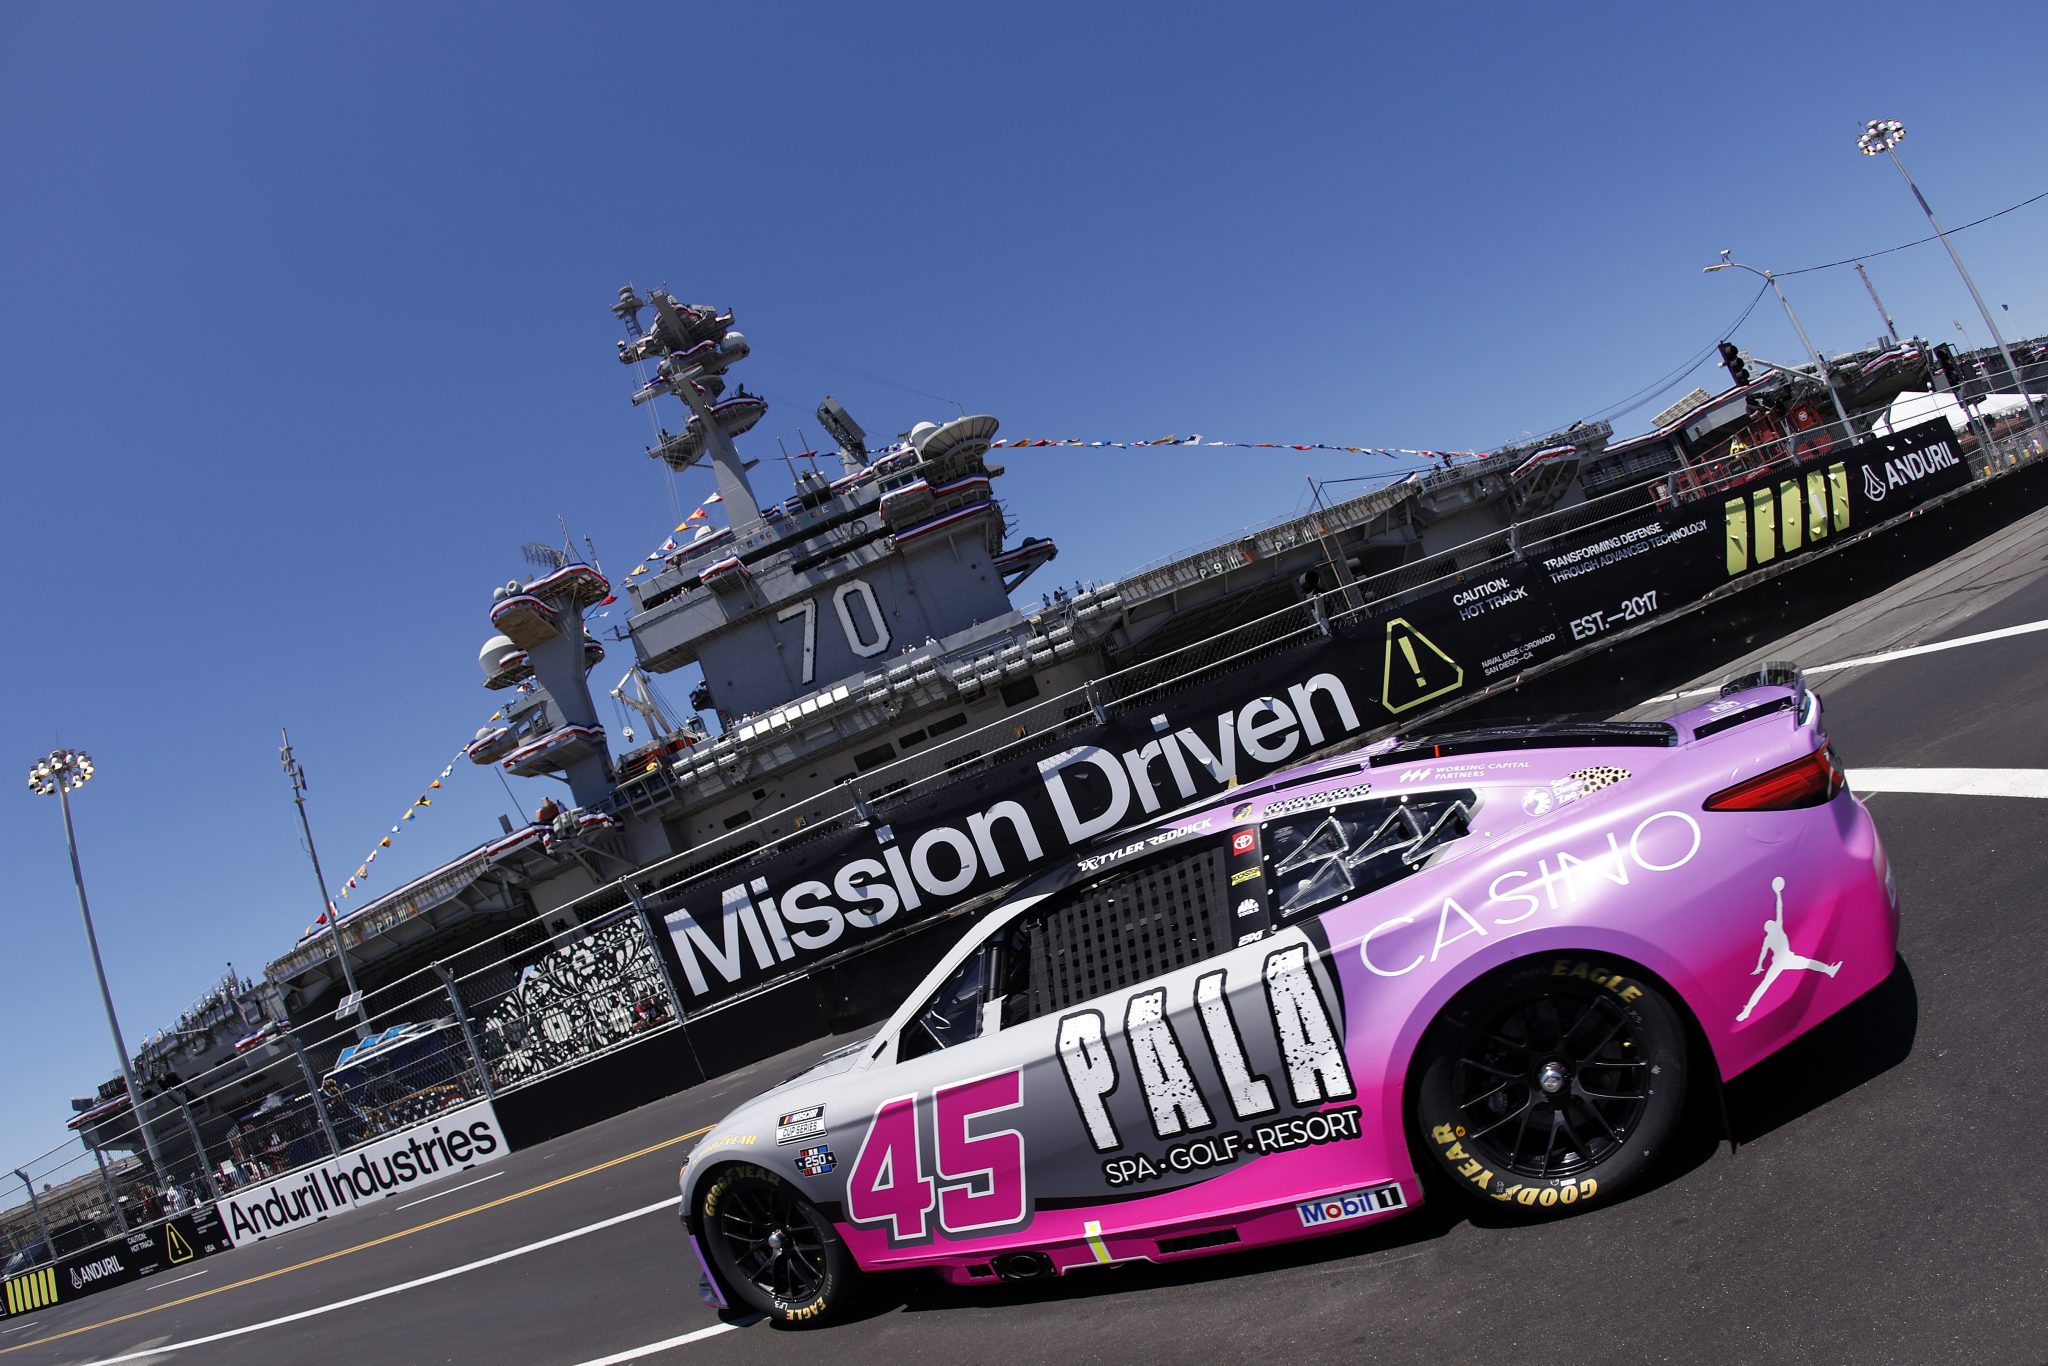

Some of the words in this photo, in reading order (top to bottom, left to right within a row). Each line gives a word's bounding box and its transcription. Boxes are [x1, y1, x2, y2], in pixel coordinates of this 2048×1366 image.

[1884, 440, 1960, 490] ANDURIL
[1543, 537, 1621, 571] TRANSFORMING
[1620, 522, 1663, 545] DEFENSE
[1549, 558, 1600, 584] THROUGH
[1600, 541, 1650, 567] ADVANCED
[1649, 519, 1708, 547] TECHNOLOGY
[1453, 577, 1510, 606] CAUTION:
[1459, 602, 1485, 621] HOT
[1486, 585, 1528, 610] TRACK
[776, 579, 892, 684] 70
[1481, 656, 1502, 669] NAVAL
[1503, 647, 1520, 659] BASE
[1520, 633, 1556, 652] CORONADO
[1484, 666, 1499, 676] SAN
[1434, 770, 1485, 780] PARTNERS
[1435, 763, 1486, 773] WORKING
[1487, 761, 1531, 770] CAPITAL
[664, 800, 1043, 996] Mission
[1037, 673, 1361, 845] Driven
[1098, 840, 1145, 865] TYLER
[1145, 817, 1213, 847] REDDICK
[1359, 811, 1703, 977] CASINO
[1553, 959, 1643, 1003] EAGLE
[1059, 946, 1353, 1150] PALA
[783, 1126, 795, 1137] CUP
[796, 1121, 818, 1135] SERIES
[792, 1108, 819, 1123] NASCAR
[805, 1154, 827, 1168] 250
[848, 1065, 1026, 1240] 45
[1106, 1157, 1157, 1184] SPA
[1170, 1135, 1239, 1170] GOLF
[1256, 1110, 1359, 1151] RESORT
[1432, 1121, 1495, 1190] YEAR
[229, 1172, 328, 1240] Anduril
[321, 1121, 497, 1208] Industries
[1300, 1192, 1374, 1224] Mobil
[80, 1255, 124, 1284] ANDURIL
[787, 1295, 827, 1321] EAGLE
